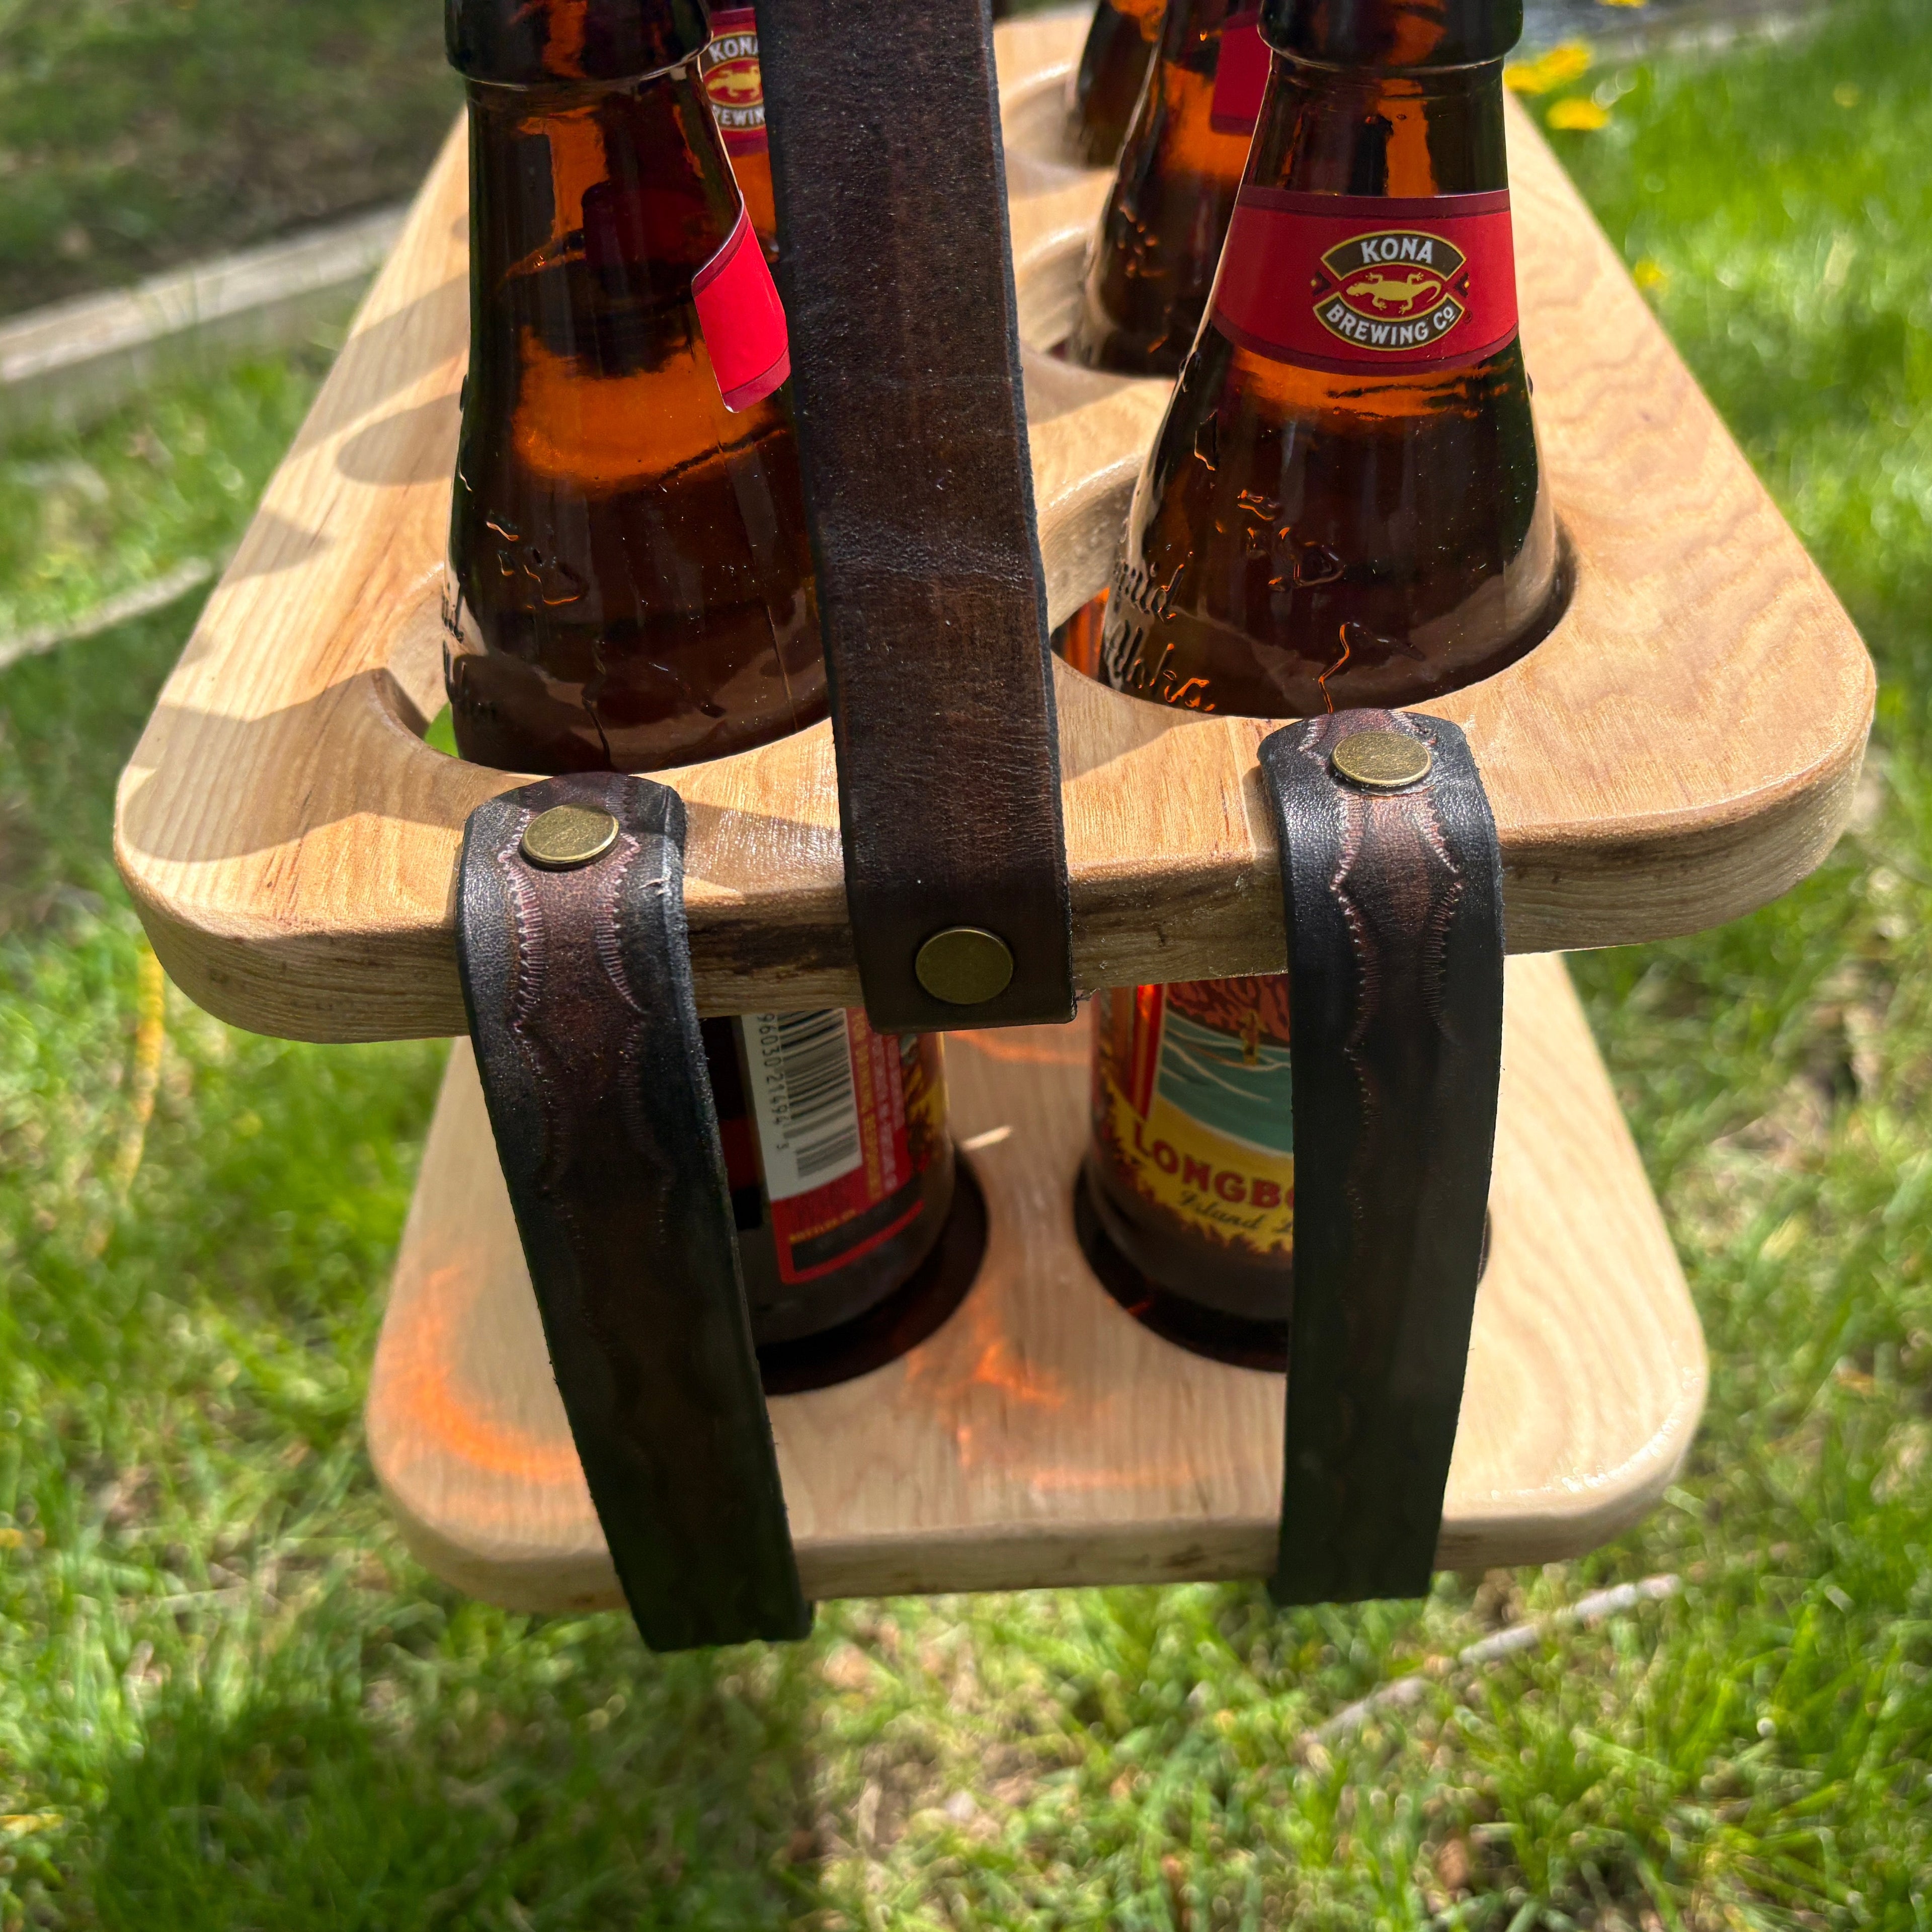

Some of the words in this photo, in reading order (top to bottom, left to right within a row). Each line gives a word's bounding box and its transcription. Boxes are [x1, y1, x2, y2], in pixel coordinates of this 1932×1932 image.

[1360, 238, 1433, 264] KONA
[1326, 304, 1428, 345] BREWING
[1132, 1119, 1293, 1209] LONGB
